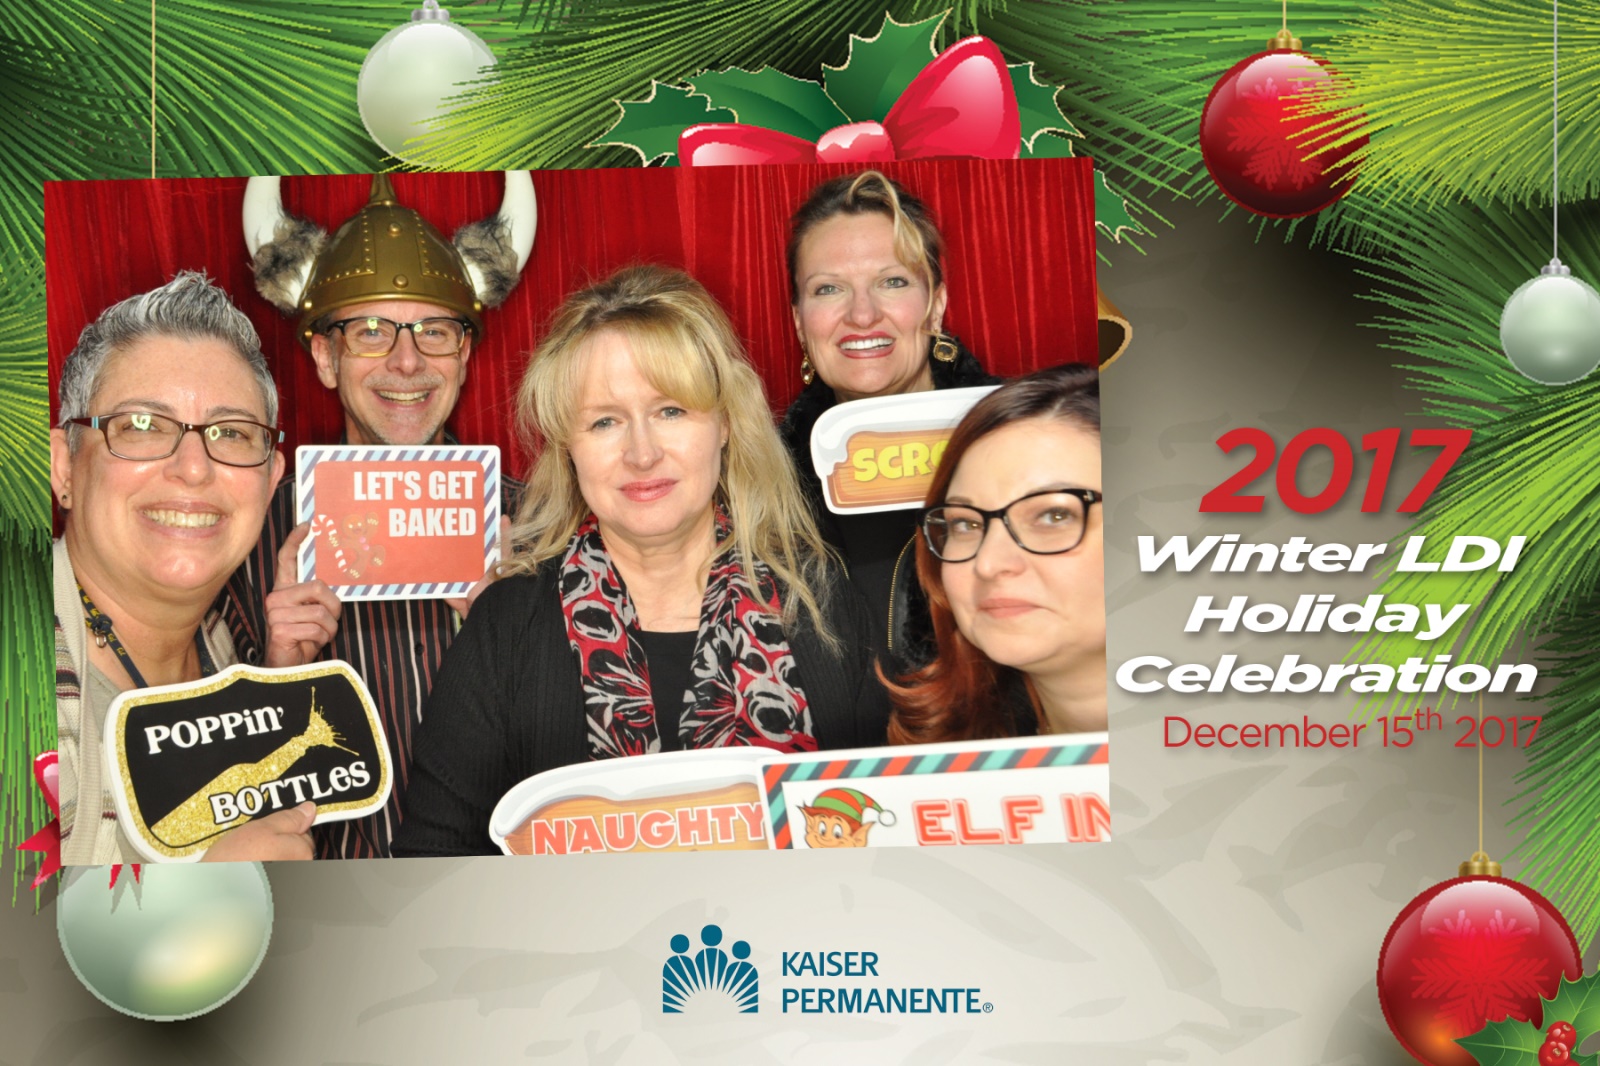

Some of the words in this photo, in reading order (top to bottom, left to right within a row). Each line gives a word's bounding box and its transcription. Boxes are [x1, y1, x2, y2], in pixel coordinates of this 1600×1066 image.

[353, 470, 421, 501] LET'S
[428, 470, 477, 500] GET
[388, 507, 477, 537] BAKED
[531, 802, 765, 855] NAUGHTY
[911, 795, 1044, 846] ELF
